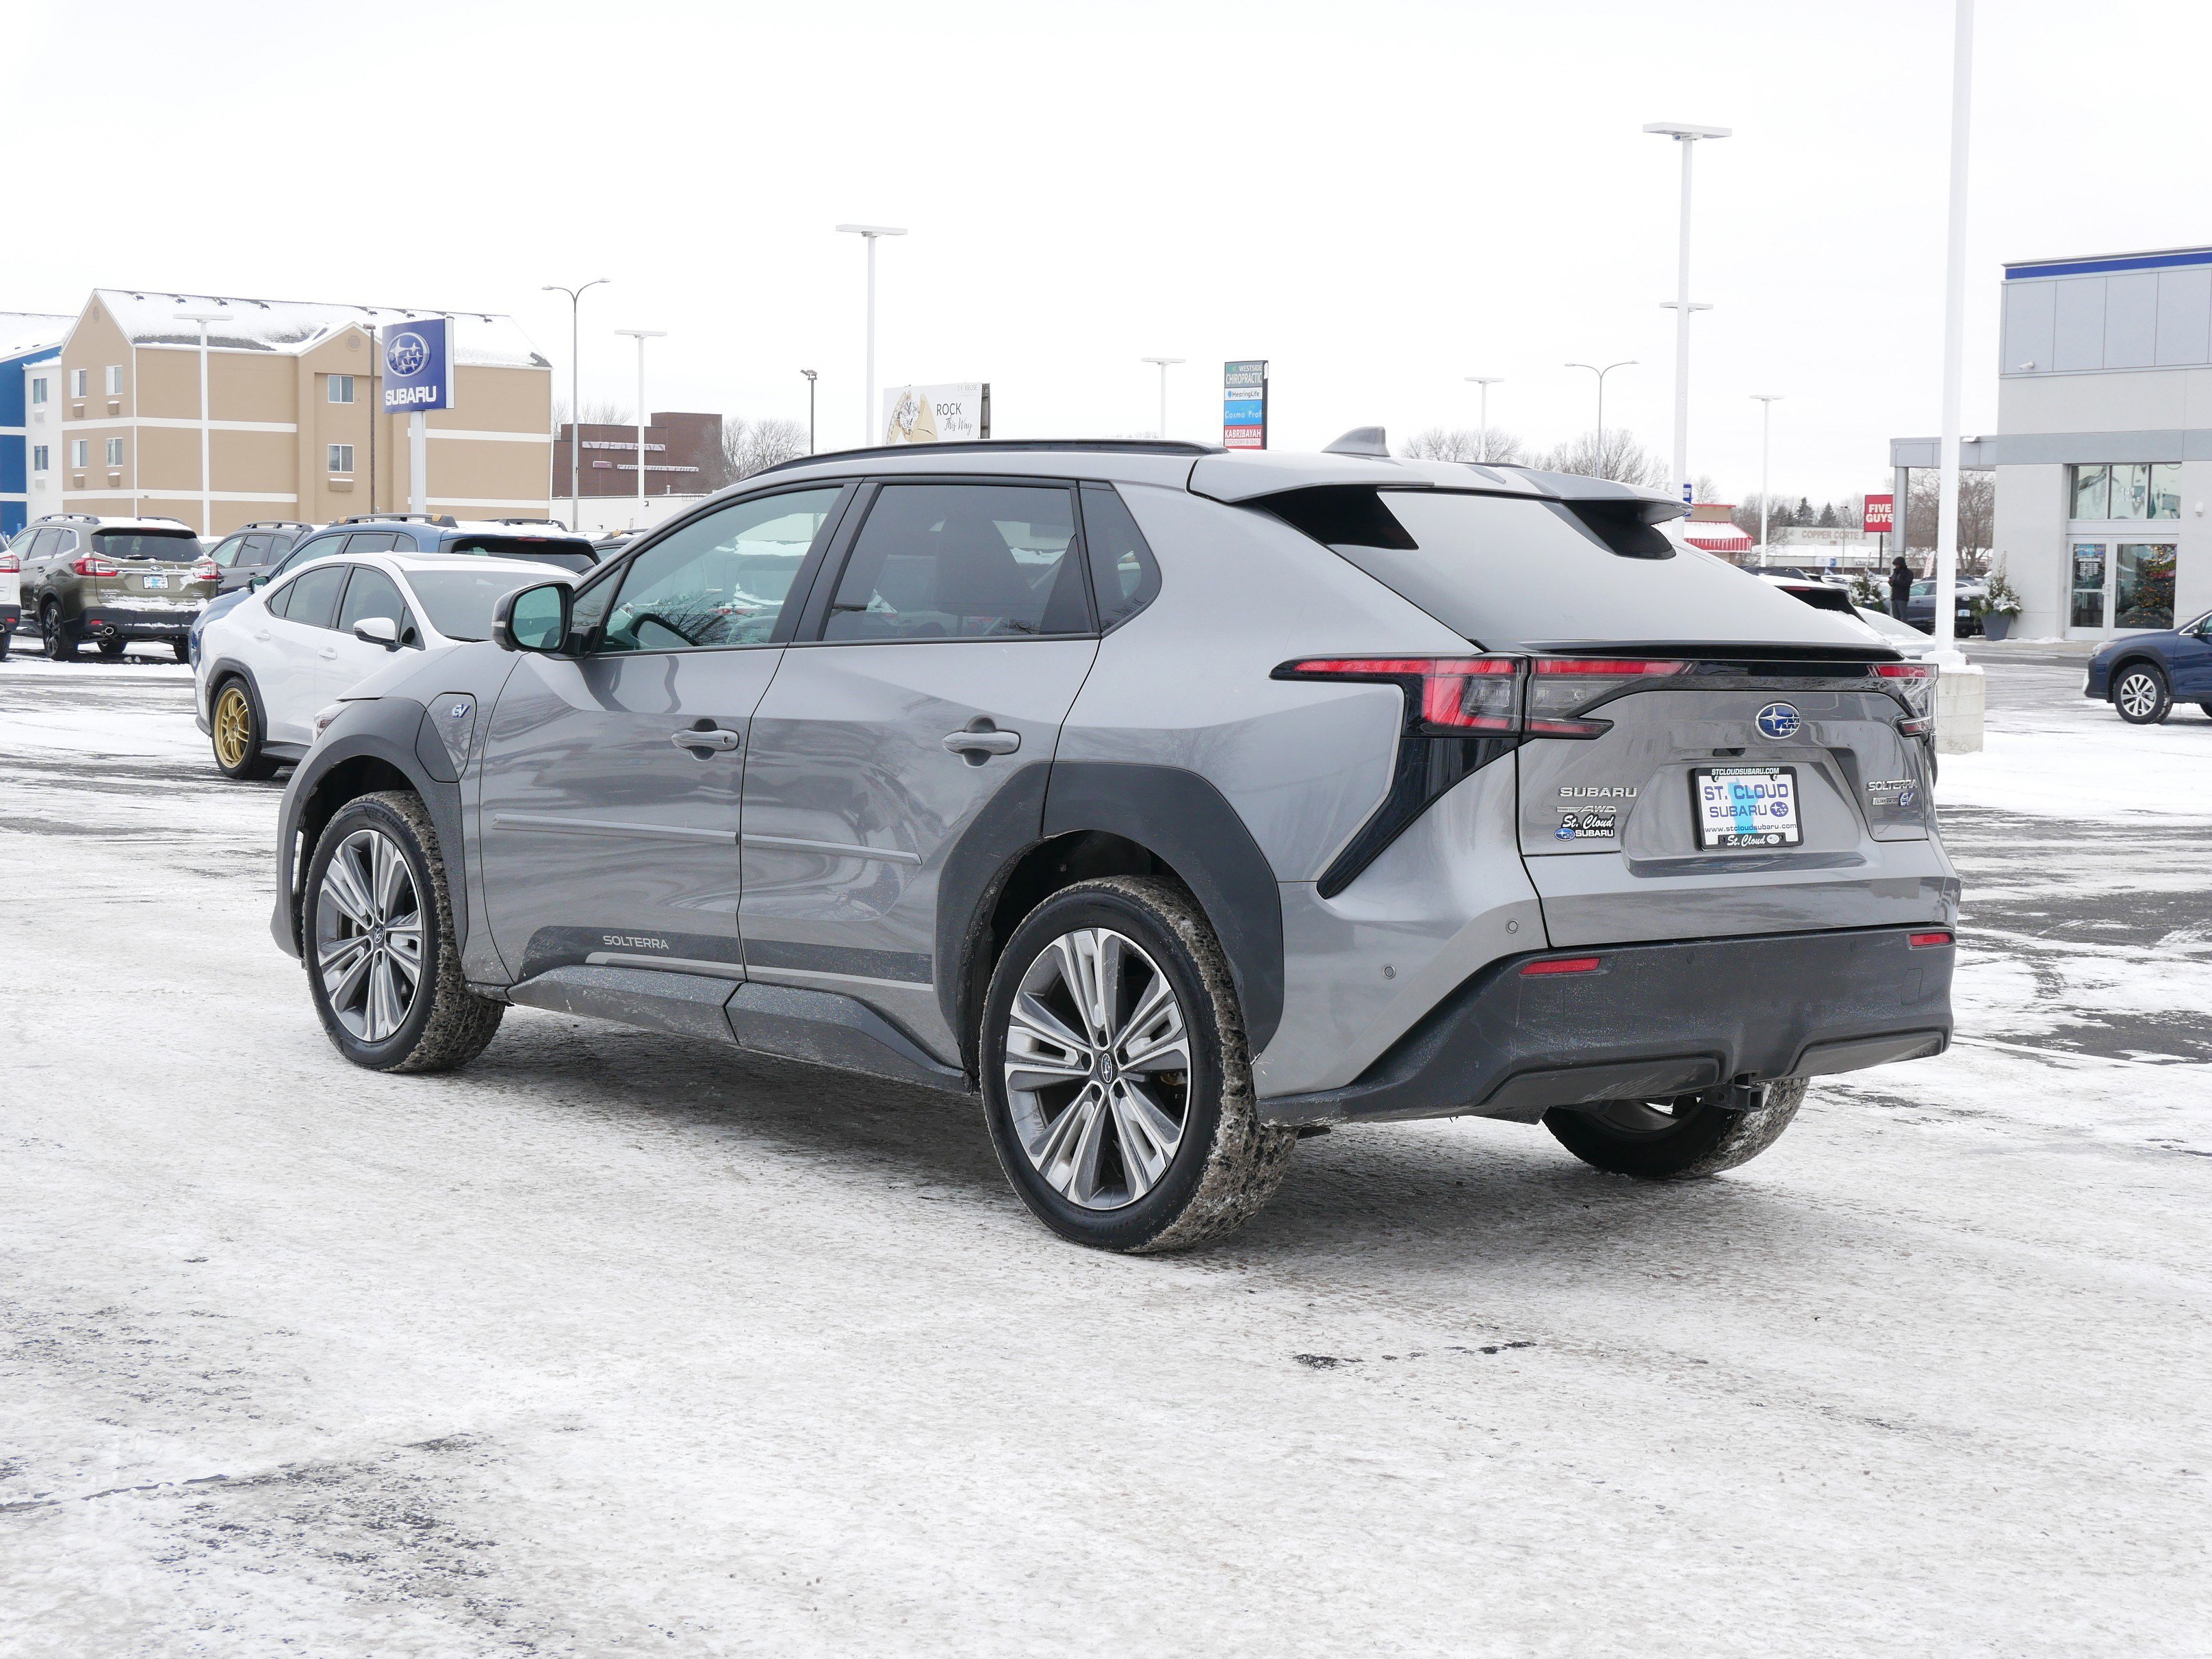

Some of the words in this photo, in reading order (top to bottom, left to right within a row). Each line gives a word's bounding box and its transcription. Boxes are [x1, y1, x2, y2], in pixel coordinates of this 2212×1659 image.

[1226, 372, 1263, 385] CHIROPRACTIC
[385, 385, 437, 406] SUBARU
[1232, 390, 1260, 398] HearingLife
[936, 402, 962, 416] ROCK
[1248, 409, 1262, 417] Prof
[944, 414, 957, 432] This
[957, 417, 973, 436] Way
[1224, 428, 1261, 439] KABRIBAYAH
[2120, 487, 2135, 496] 141
[1868, 504, 1892, 513] FIVE
[1866, 513, 1894, 523] GUYS
[1802, 530, 1831, 539] COPPER
[1711, 767, 1779, 775] STCLOUDSUBARU.COM
[1867, 779, 1918, 791] SOLTERRA
[1560, 787, 1637, 797] SUBARU
[1704, 786, 1728, 801] ST.
[1734, 784, 1789, 800] CLOUD
[1580, 805, 1617, 813] AWD
[1709, 804, 1767, 818] SUBARU
[1562, 814, 1579, 828] St.
[1582, 814, 1615, 830] Cloud
[1705, 823, 1797, 833] www.stcloudsubaru.com
[1727, 834, 1740, 846] St.
[1741, 834, 1766, 847] Cloud
[602, 935, 670, 950] SOLTERRA
